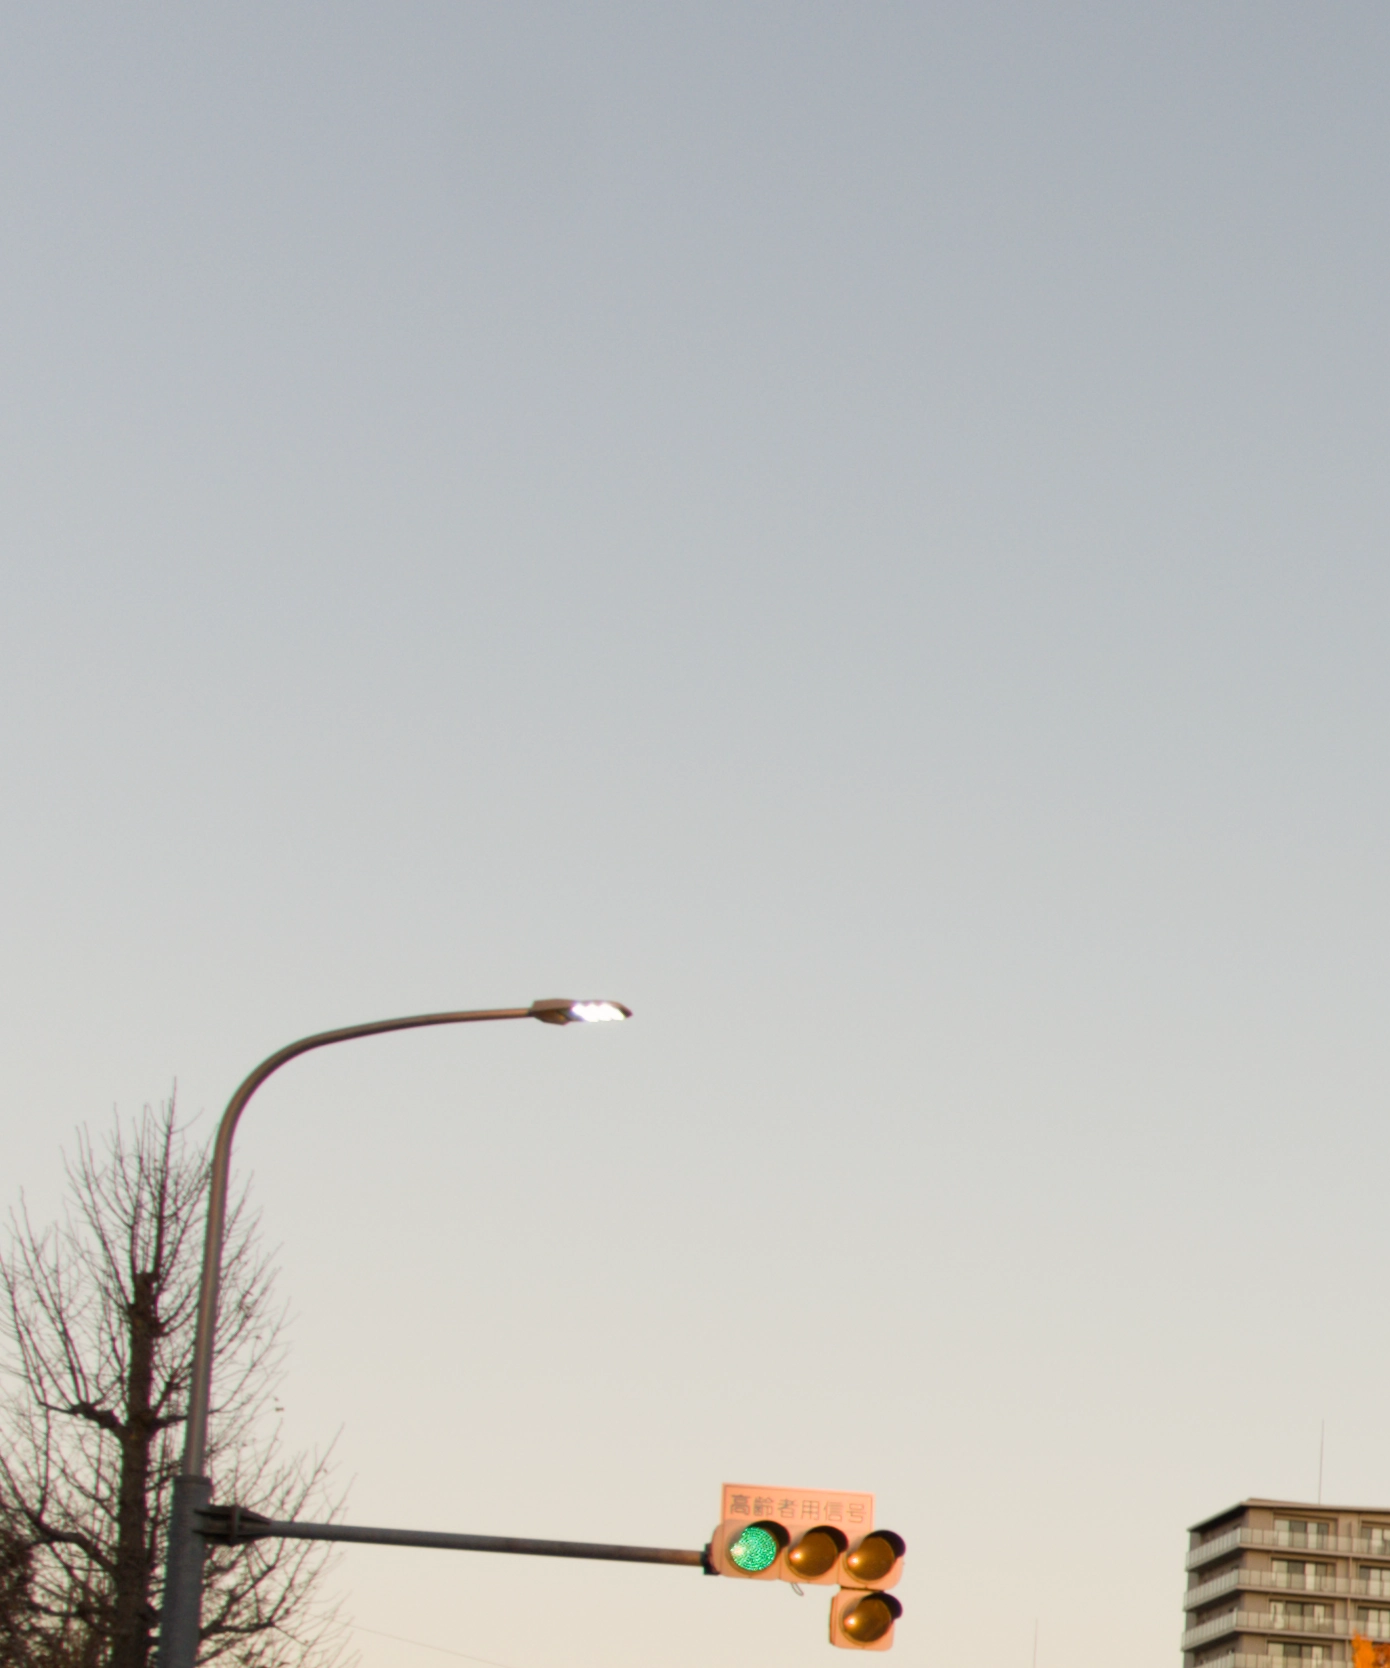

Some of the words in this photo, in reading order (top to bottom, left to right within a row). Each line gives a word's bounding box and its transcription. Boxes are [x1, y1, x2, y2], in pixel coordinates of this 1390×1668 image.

[730, 1494, 867, 1524] 高齢者用信号
